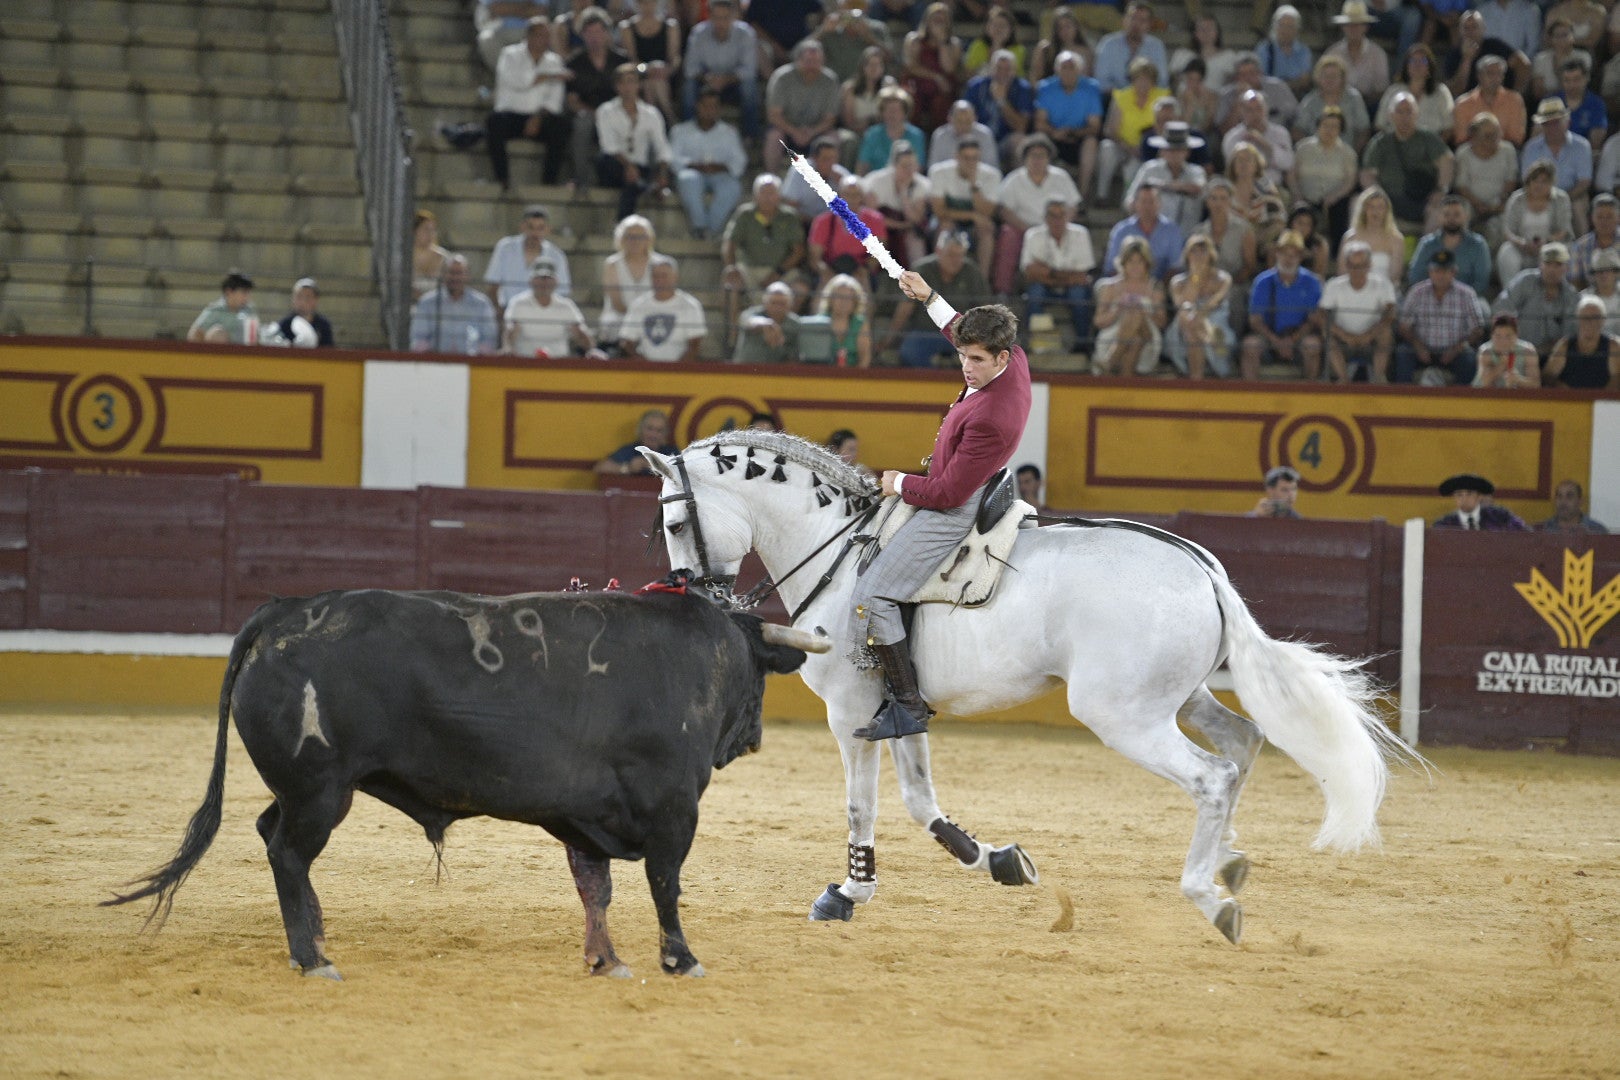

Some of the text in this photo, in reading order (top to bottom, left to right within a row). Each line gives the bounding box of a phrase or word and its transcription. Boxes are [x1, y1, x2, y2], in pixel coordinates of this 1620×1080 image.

[93, 393, 114, 430] 3
[1300, 430, 1322, 468] 4
[1483, 651, 1620, 677] CAJA RURAL
[1477, 671, 1620, 697] EXTREMAD
